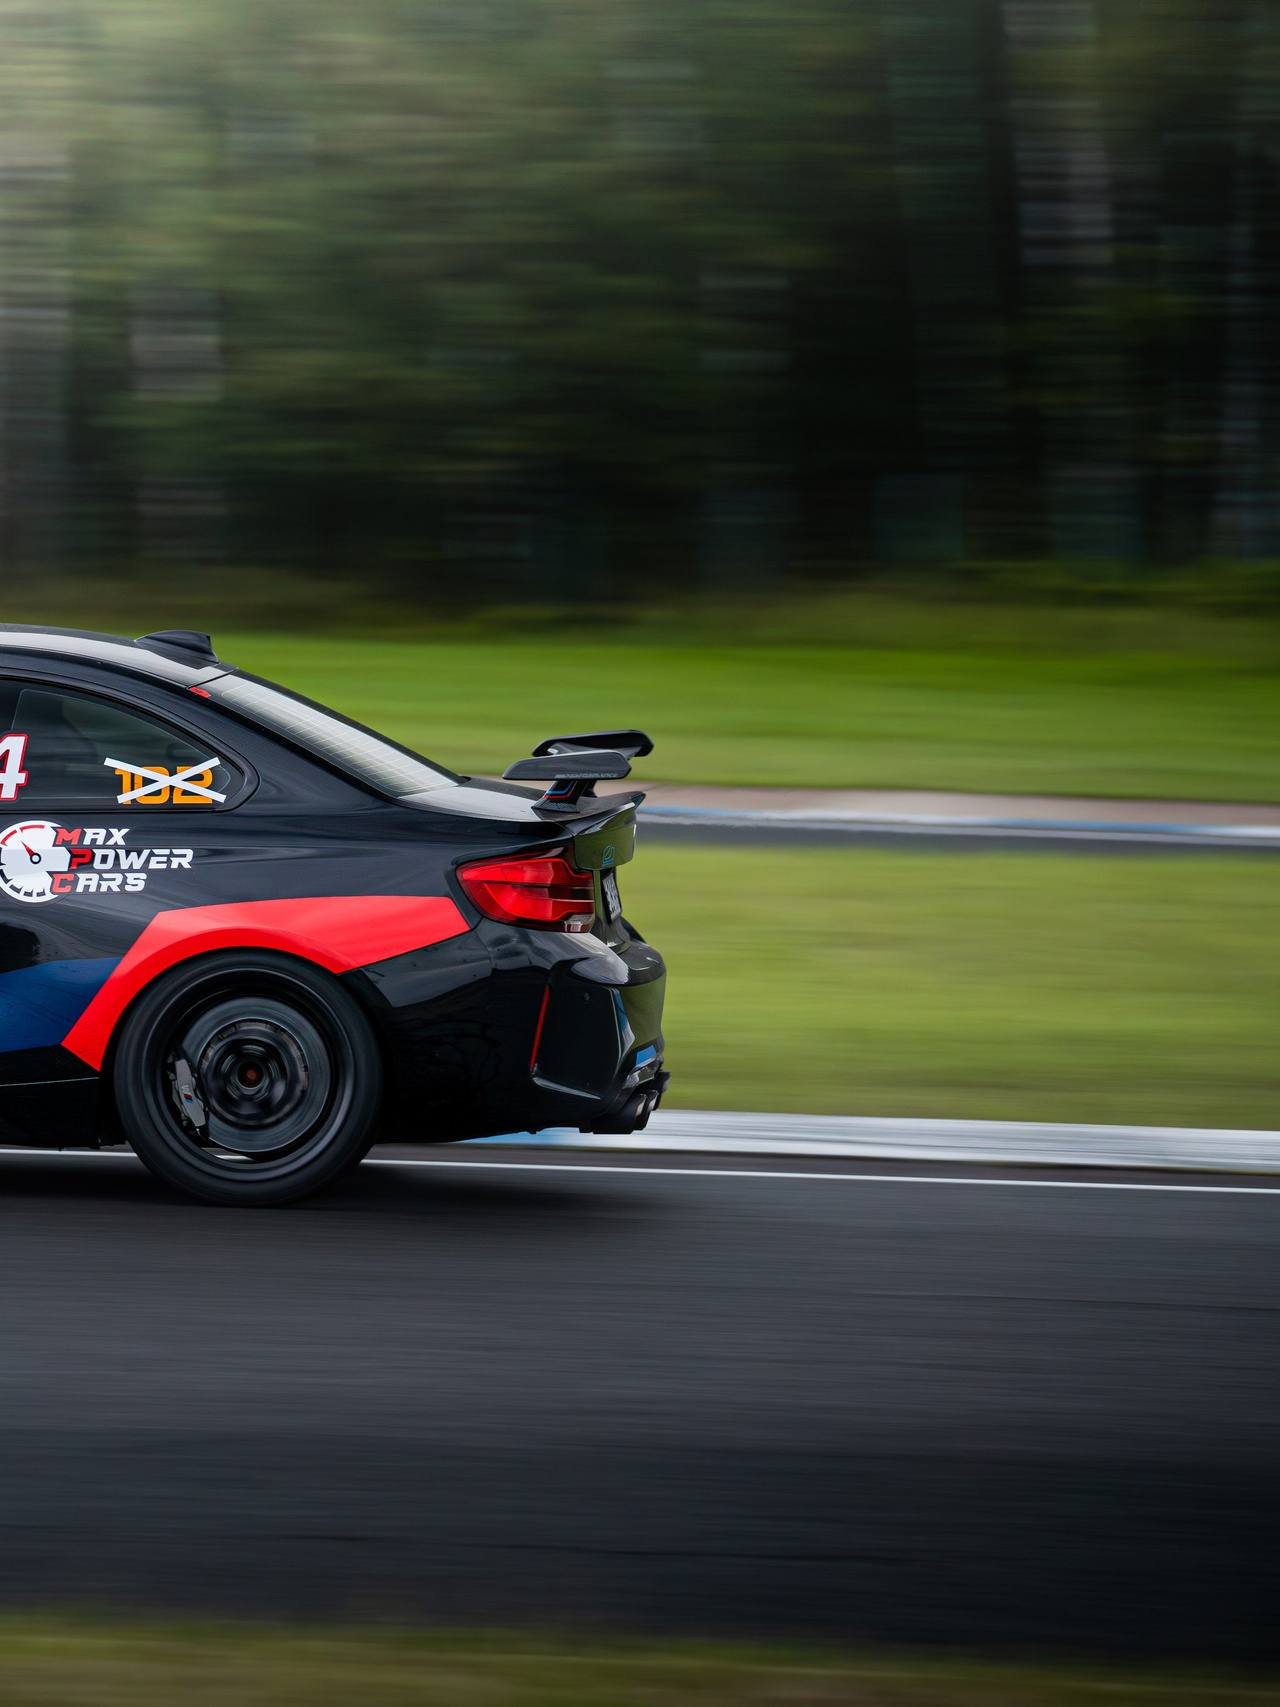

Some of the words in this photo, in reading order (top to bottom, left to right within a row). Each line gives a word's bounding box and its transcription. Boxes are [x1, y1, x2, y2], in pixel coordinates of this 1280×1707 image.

[115, 766, 213, 804] 102
[55, 828, 130, 846] MAX
[70, 848, 194, 870] POWER
[52, 872, 147, 893] CARS
